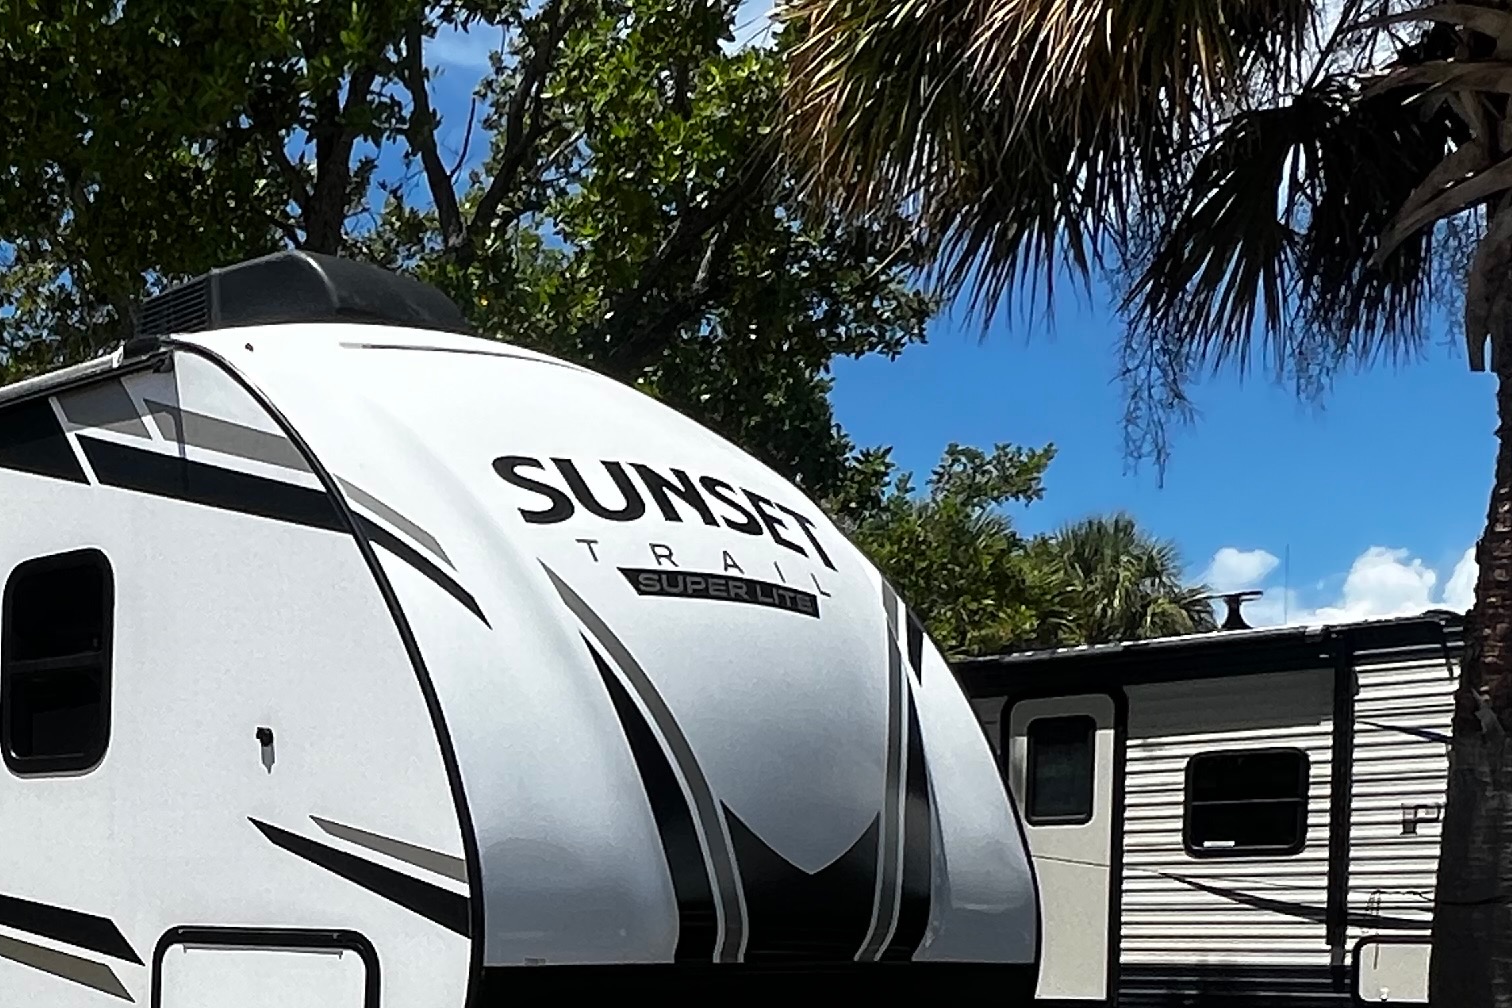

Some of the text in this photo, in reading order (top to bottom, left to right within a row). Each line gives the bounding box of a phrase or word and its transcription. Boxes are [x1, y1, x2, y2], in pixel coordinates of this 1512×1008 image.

[492, 455, 839, 572] SUNSET
[576, 538, 832, 598] TRAIL
[638, 572, 815, 612] SUPER LITE
